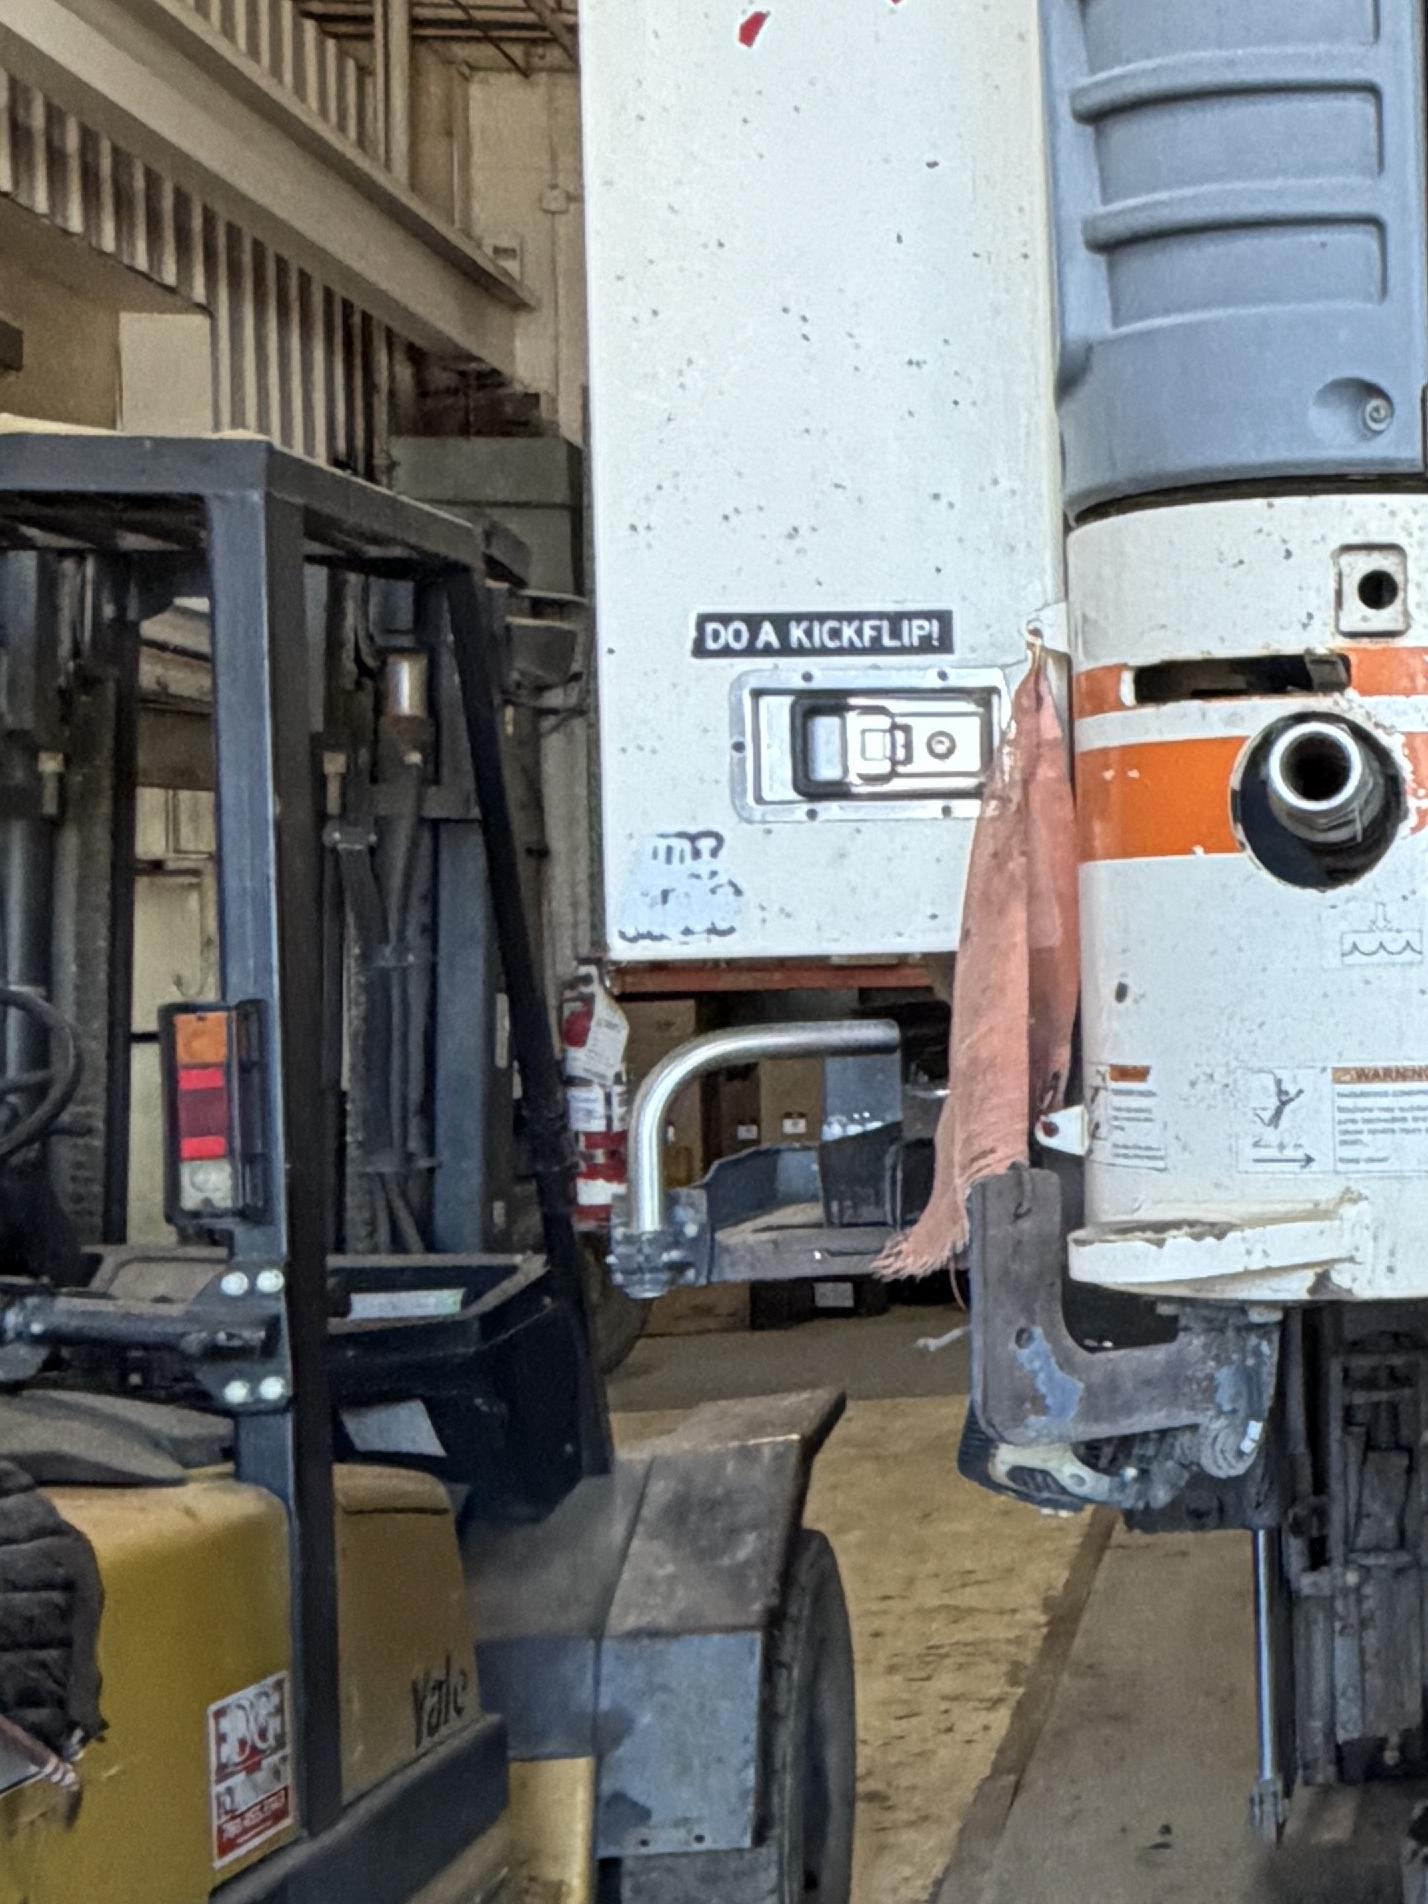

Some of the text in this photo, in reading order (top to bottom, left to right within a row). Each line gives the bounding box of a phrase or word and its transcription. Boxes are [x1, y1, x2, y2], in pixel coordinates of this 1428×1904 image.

[704, 619, 940, 650] DO A KICKFLIP!
[412, 1655, 468, 1749] Yale
